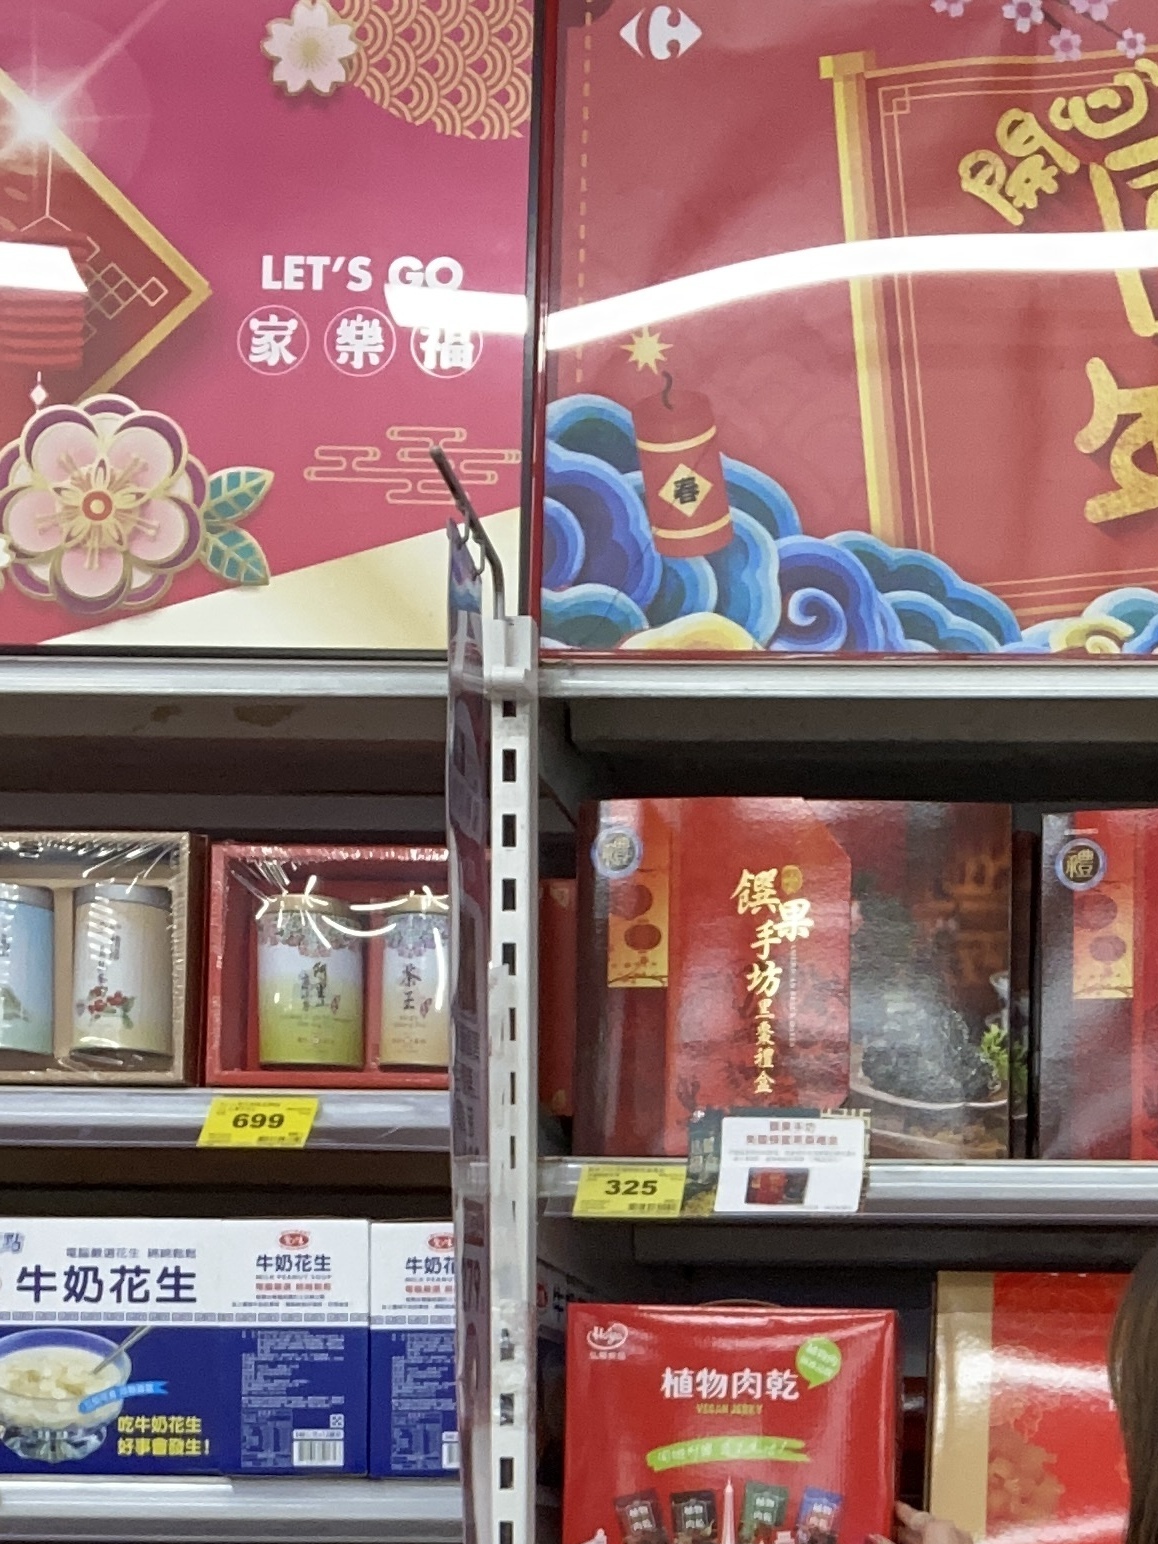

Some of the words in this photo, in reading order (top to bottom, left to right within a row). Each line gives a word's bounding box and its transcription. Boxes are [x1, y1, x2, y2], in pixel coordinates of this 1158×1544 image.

[261, 254, 373, 292] LET'S
[231, 1112, 285, 1130] 699
[605, 1179, 658, 1196] 325
[255, 1253, 332, 1273] 牛奶花生
[16, 1264, 197, 1304] 牛奶花生
[660, 1366, 800, 1401] 植物肉乾
[696, 1403, 729, 1415] VEGAN
[117, 1415, 202, 1433] 吃牛奶花生
